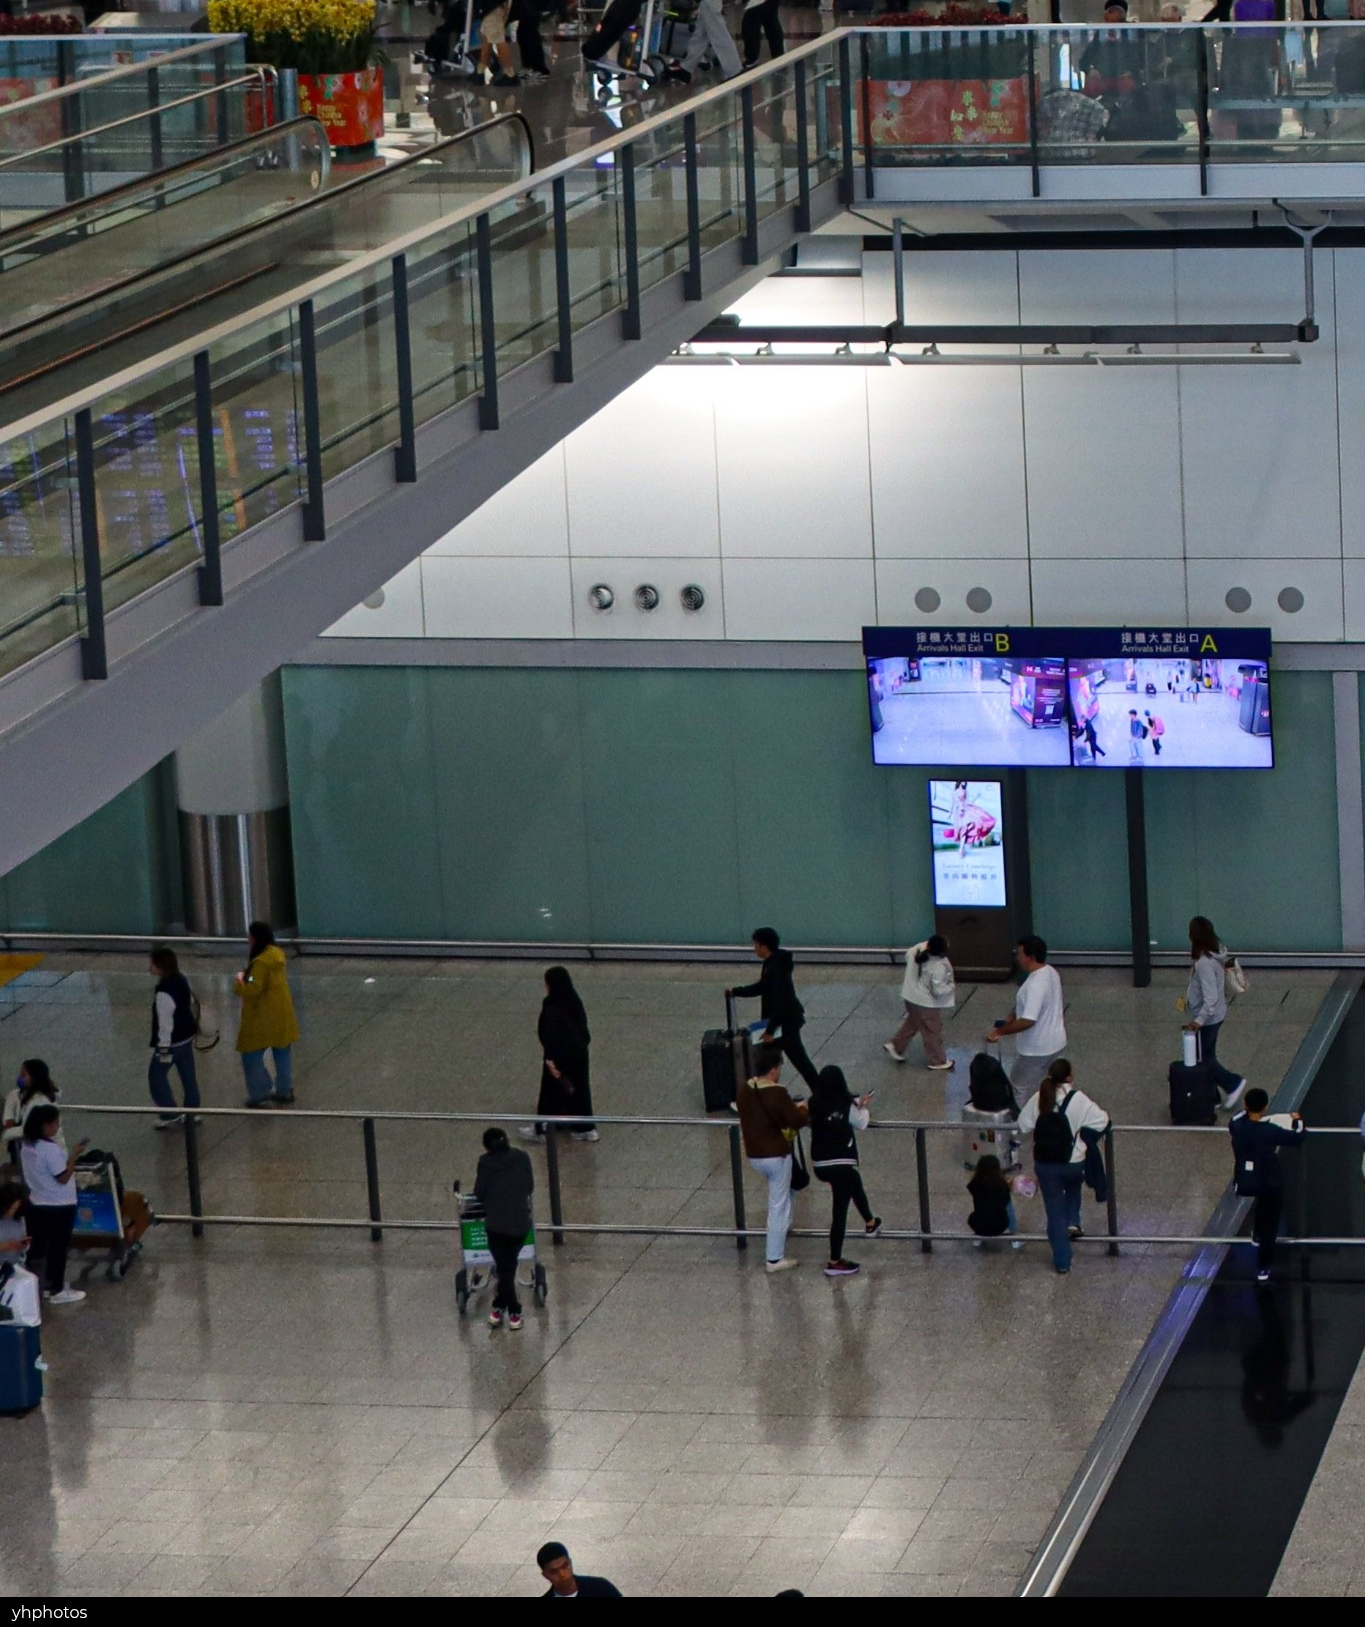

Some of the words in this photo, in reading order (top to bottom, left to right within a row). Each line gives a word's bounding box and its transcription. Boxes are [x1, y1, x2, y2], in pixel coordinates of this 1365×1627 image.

[917, 631, 993, 644] 接機大堂出口
[995, 634, 1010, 652] B
[1121, 632, 1199, 644] 接機大堂出口
[1200, 634, 1218, 652] A
[917, 644, 949, 652] Arrivals
[950, 644, 966, 652] Hall
[968, 644, 984, 652] Exit
[1122, 644, 1153, 653] Arrivals
[1155, 645, 1171, 653] Hall
[1173, 645, 1189, 653] Exit
